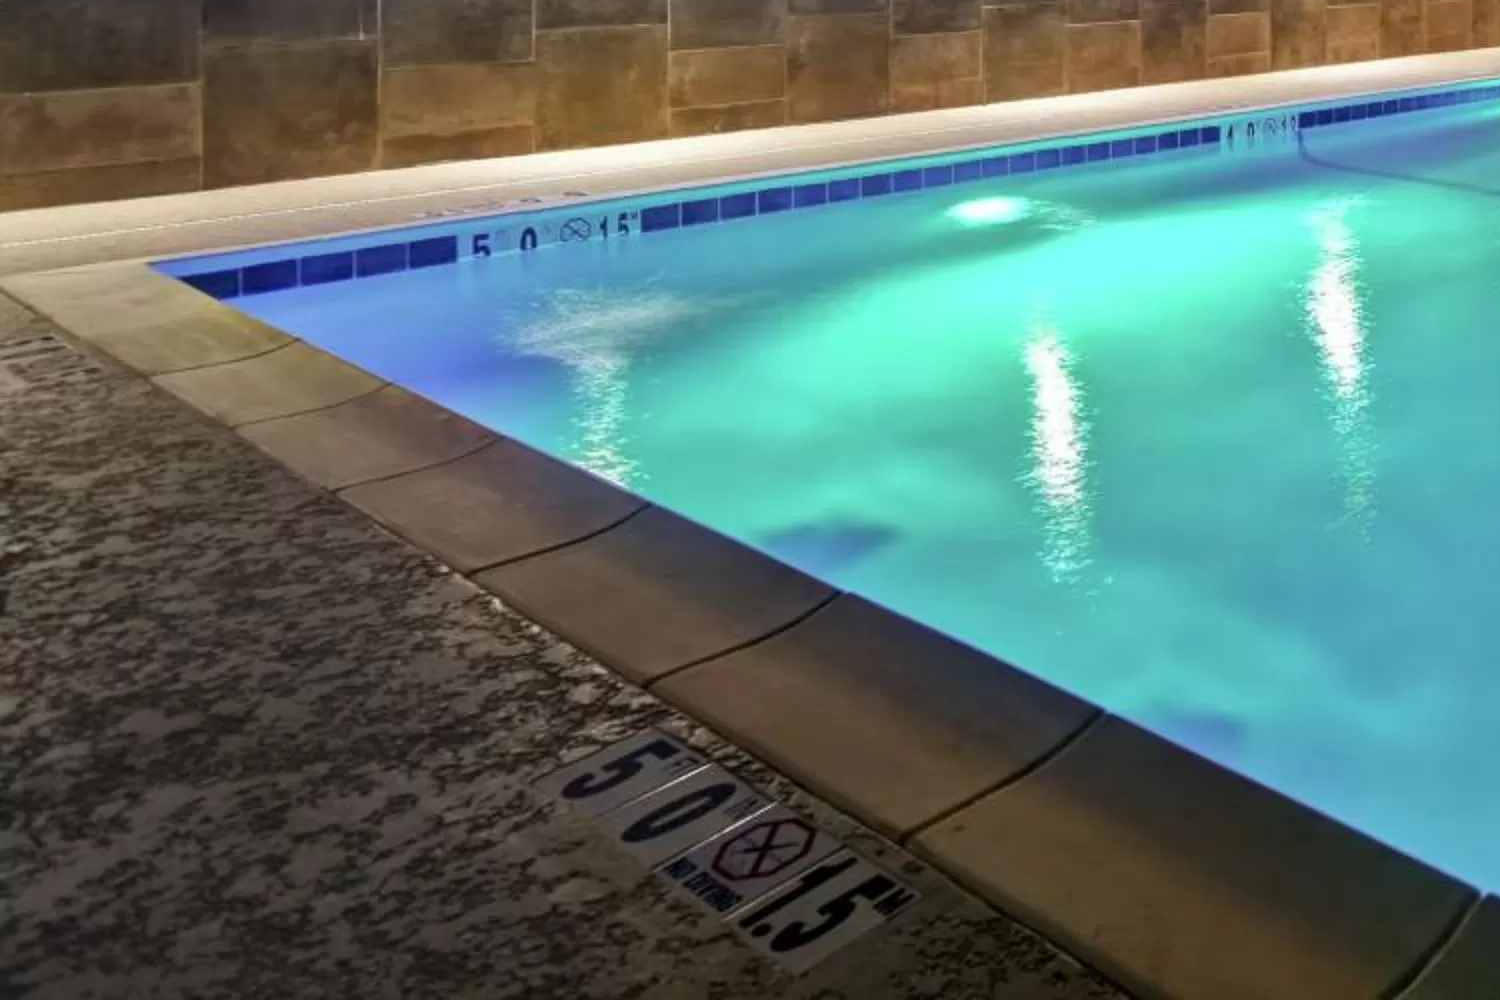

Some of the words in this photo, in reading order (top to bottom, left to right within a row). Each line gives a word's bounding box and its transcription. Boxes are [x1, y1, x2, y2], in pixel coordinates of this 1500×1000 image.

[472, 233, 491, 258] 5
[520, 226, 537, 250] 0
[562, 739, 681, 799] 5
[620, 782, 736, 843] 0
